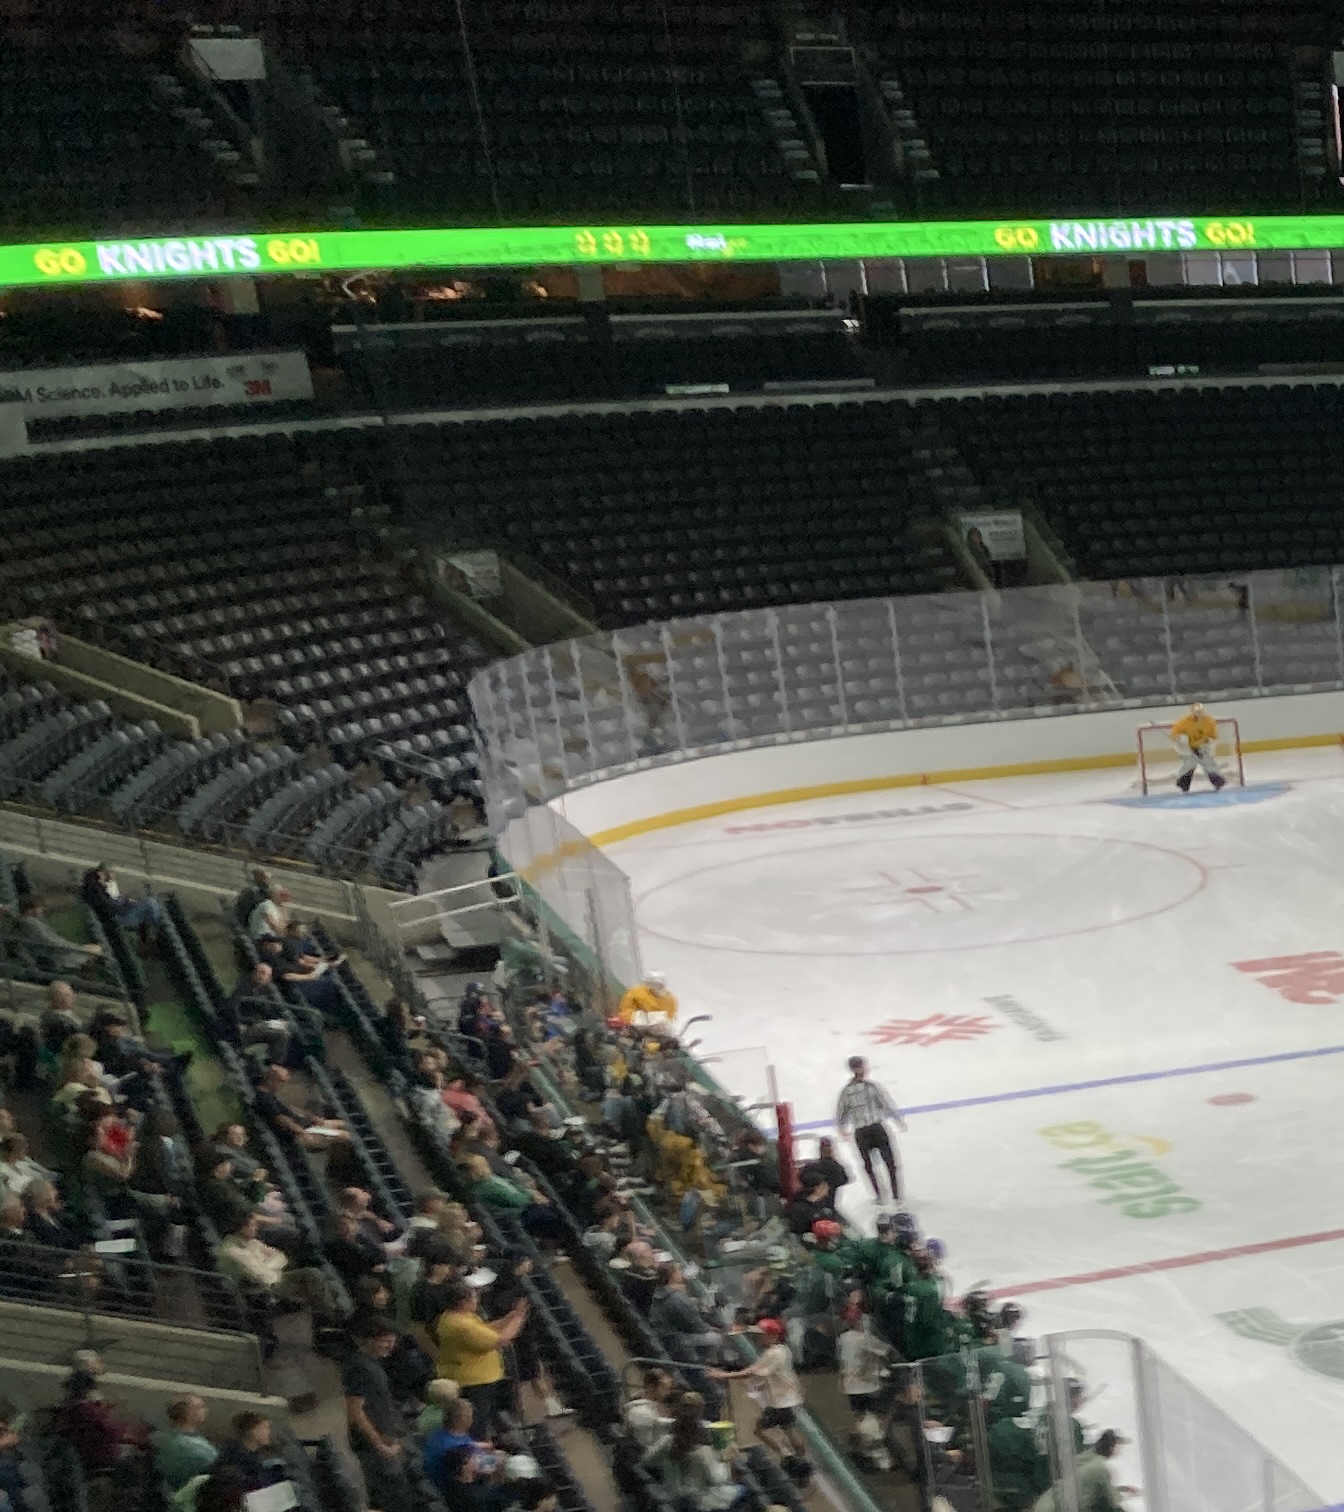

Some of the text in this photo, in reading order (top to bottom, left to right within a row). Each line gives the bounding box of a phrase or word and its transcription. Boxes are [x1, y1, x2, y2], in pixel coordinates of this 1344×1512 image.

[995, 220, 1255, 251] GO KNIGHTS GO!
[34, 236, 321, 277] GO KNIGHTS GO!
[109, 377, 169, 398] Applied
[172, 377, 189, 392] to
